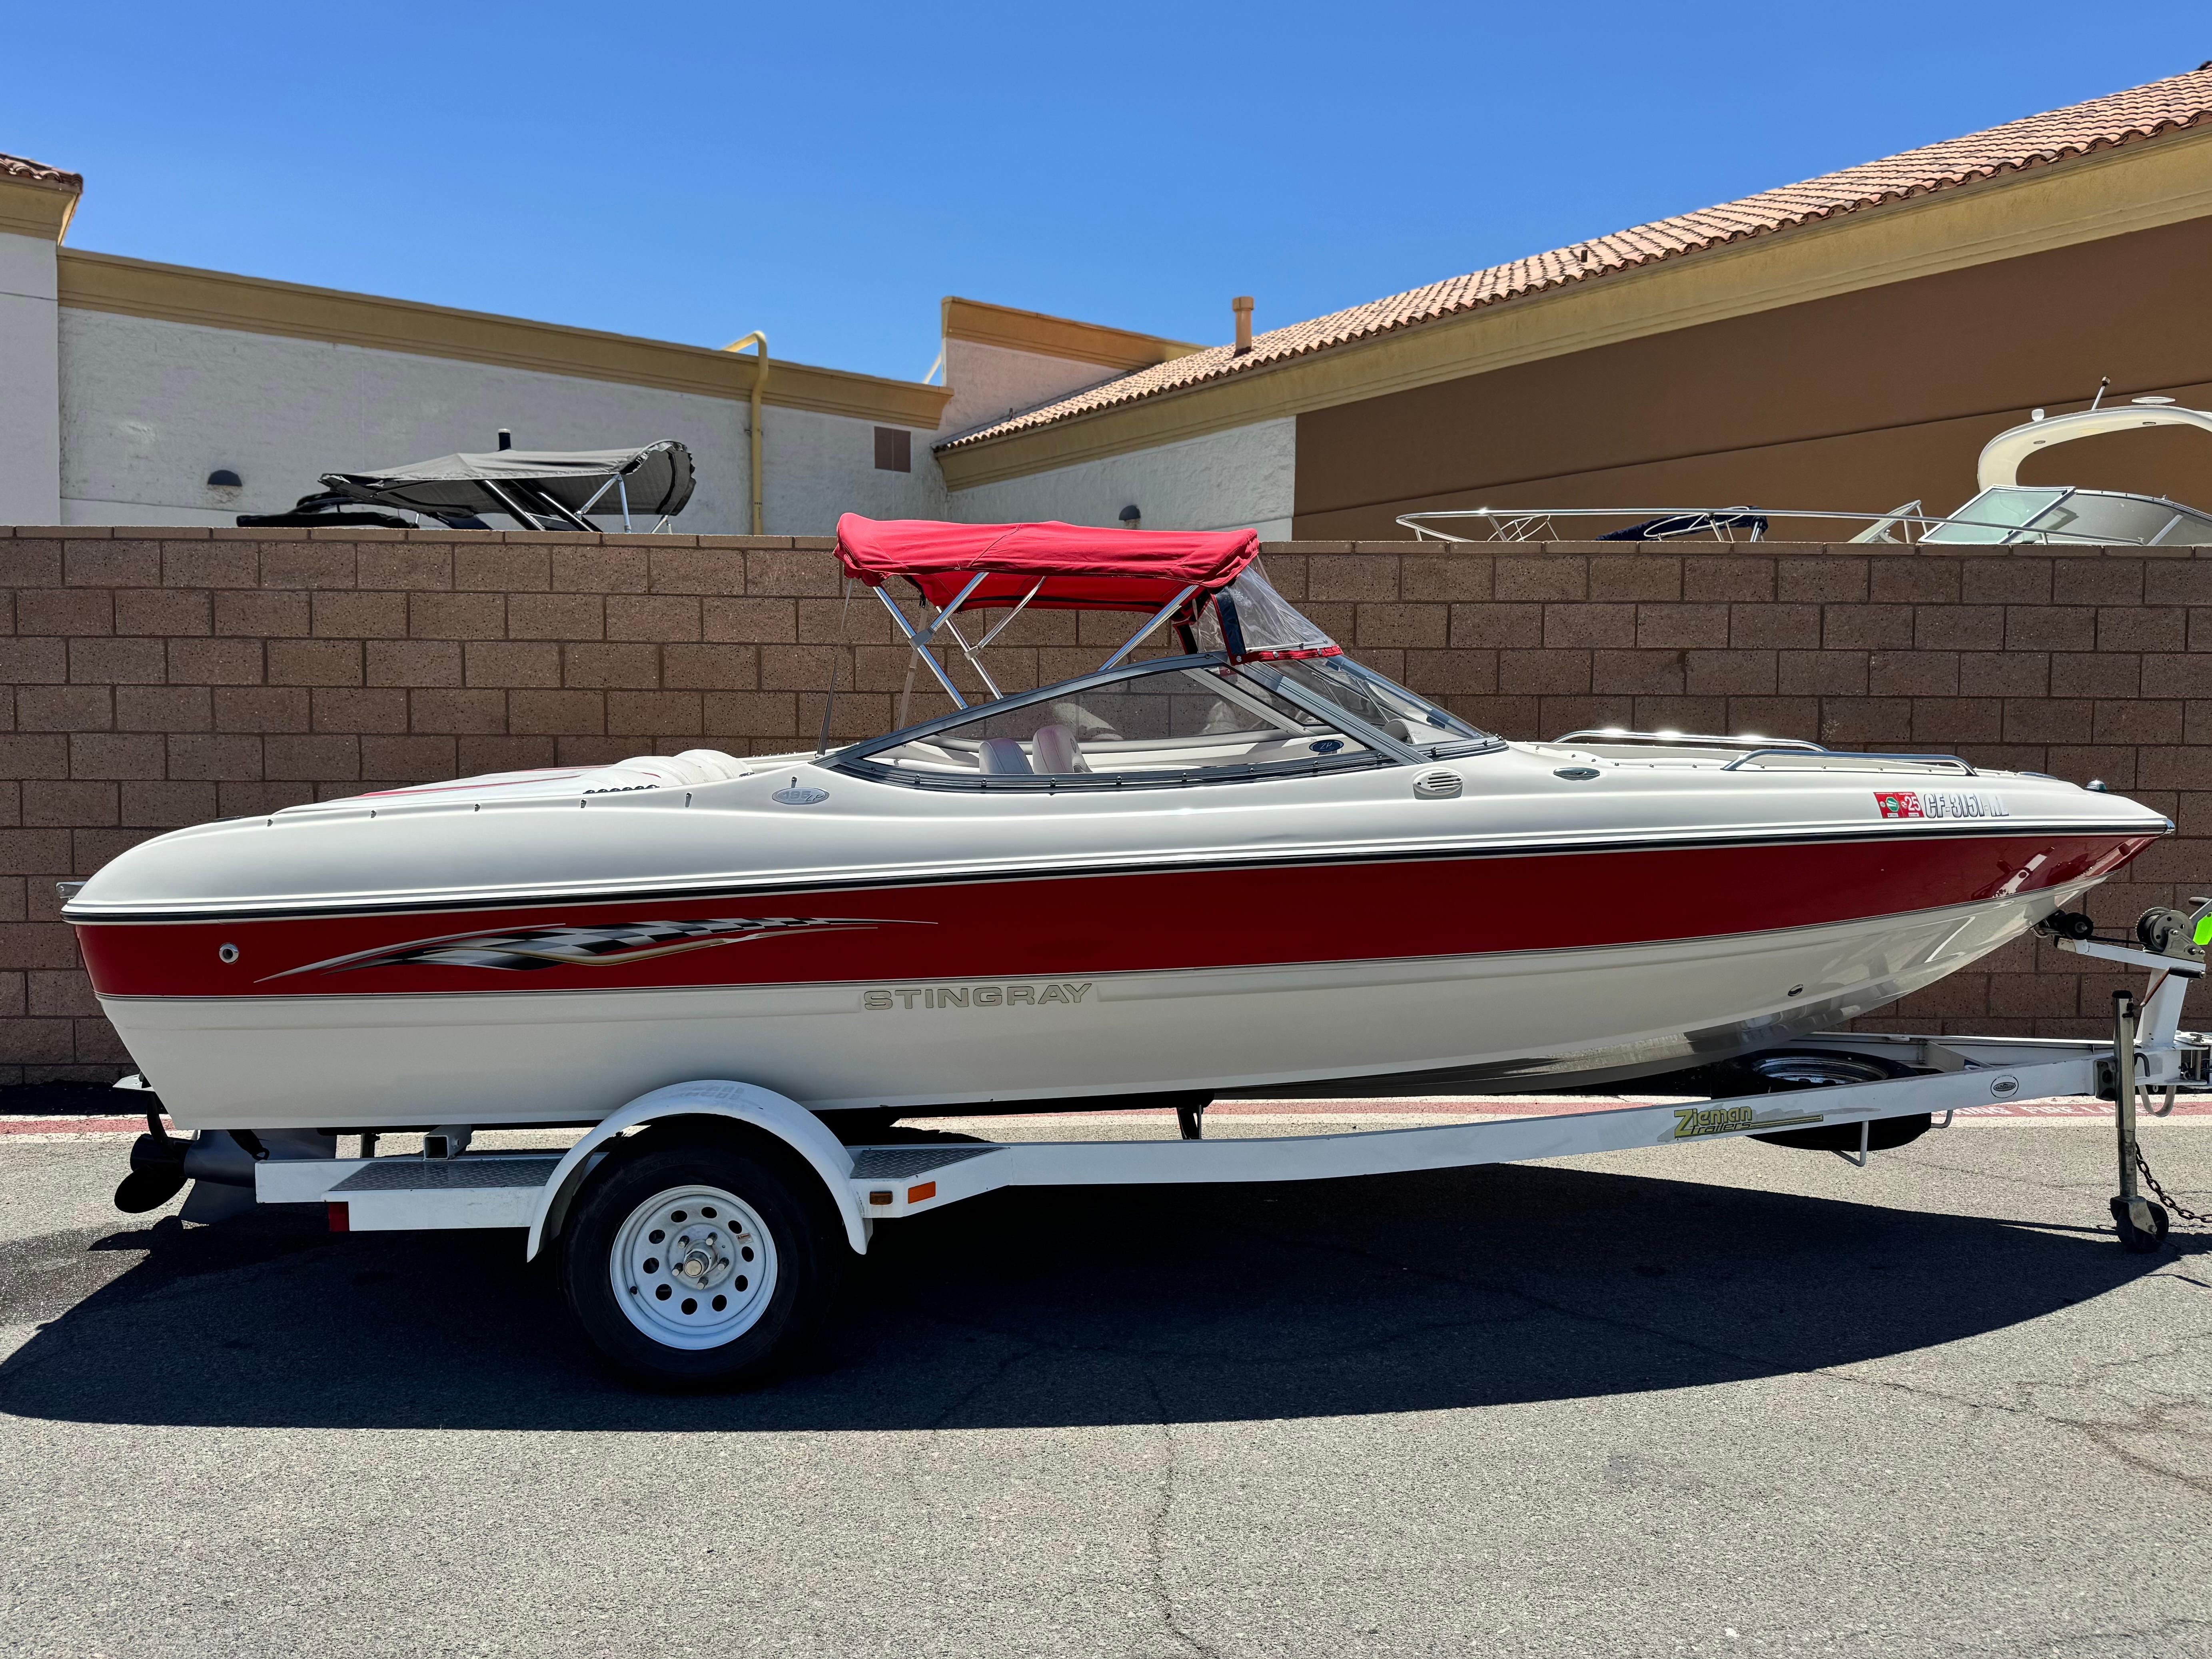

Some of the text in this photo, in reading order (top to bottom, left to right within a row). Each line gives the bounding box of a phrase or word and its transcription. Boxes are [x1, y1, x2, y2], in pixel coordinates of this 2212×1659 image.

[1904, 796, 1921, 811] 25
[863, 983, 1092, 1010] STINGRAY
[2020, 1106, 2083, 1114] FIRE
[2080, 1106, 2150, 1114] LAE
[1674, 1106, 1752, 1138] Zieman
